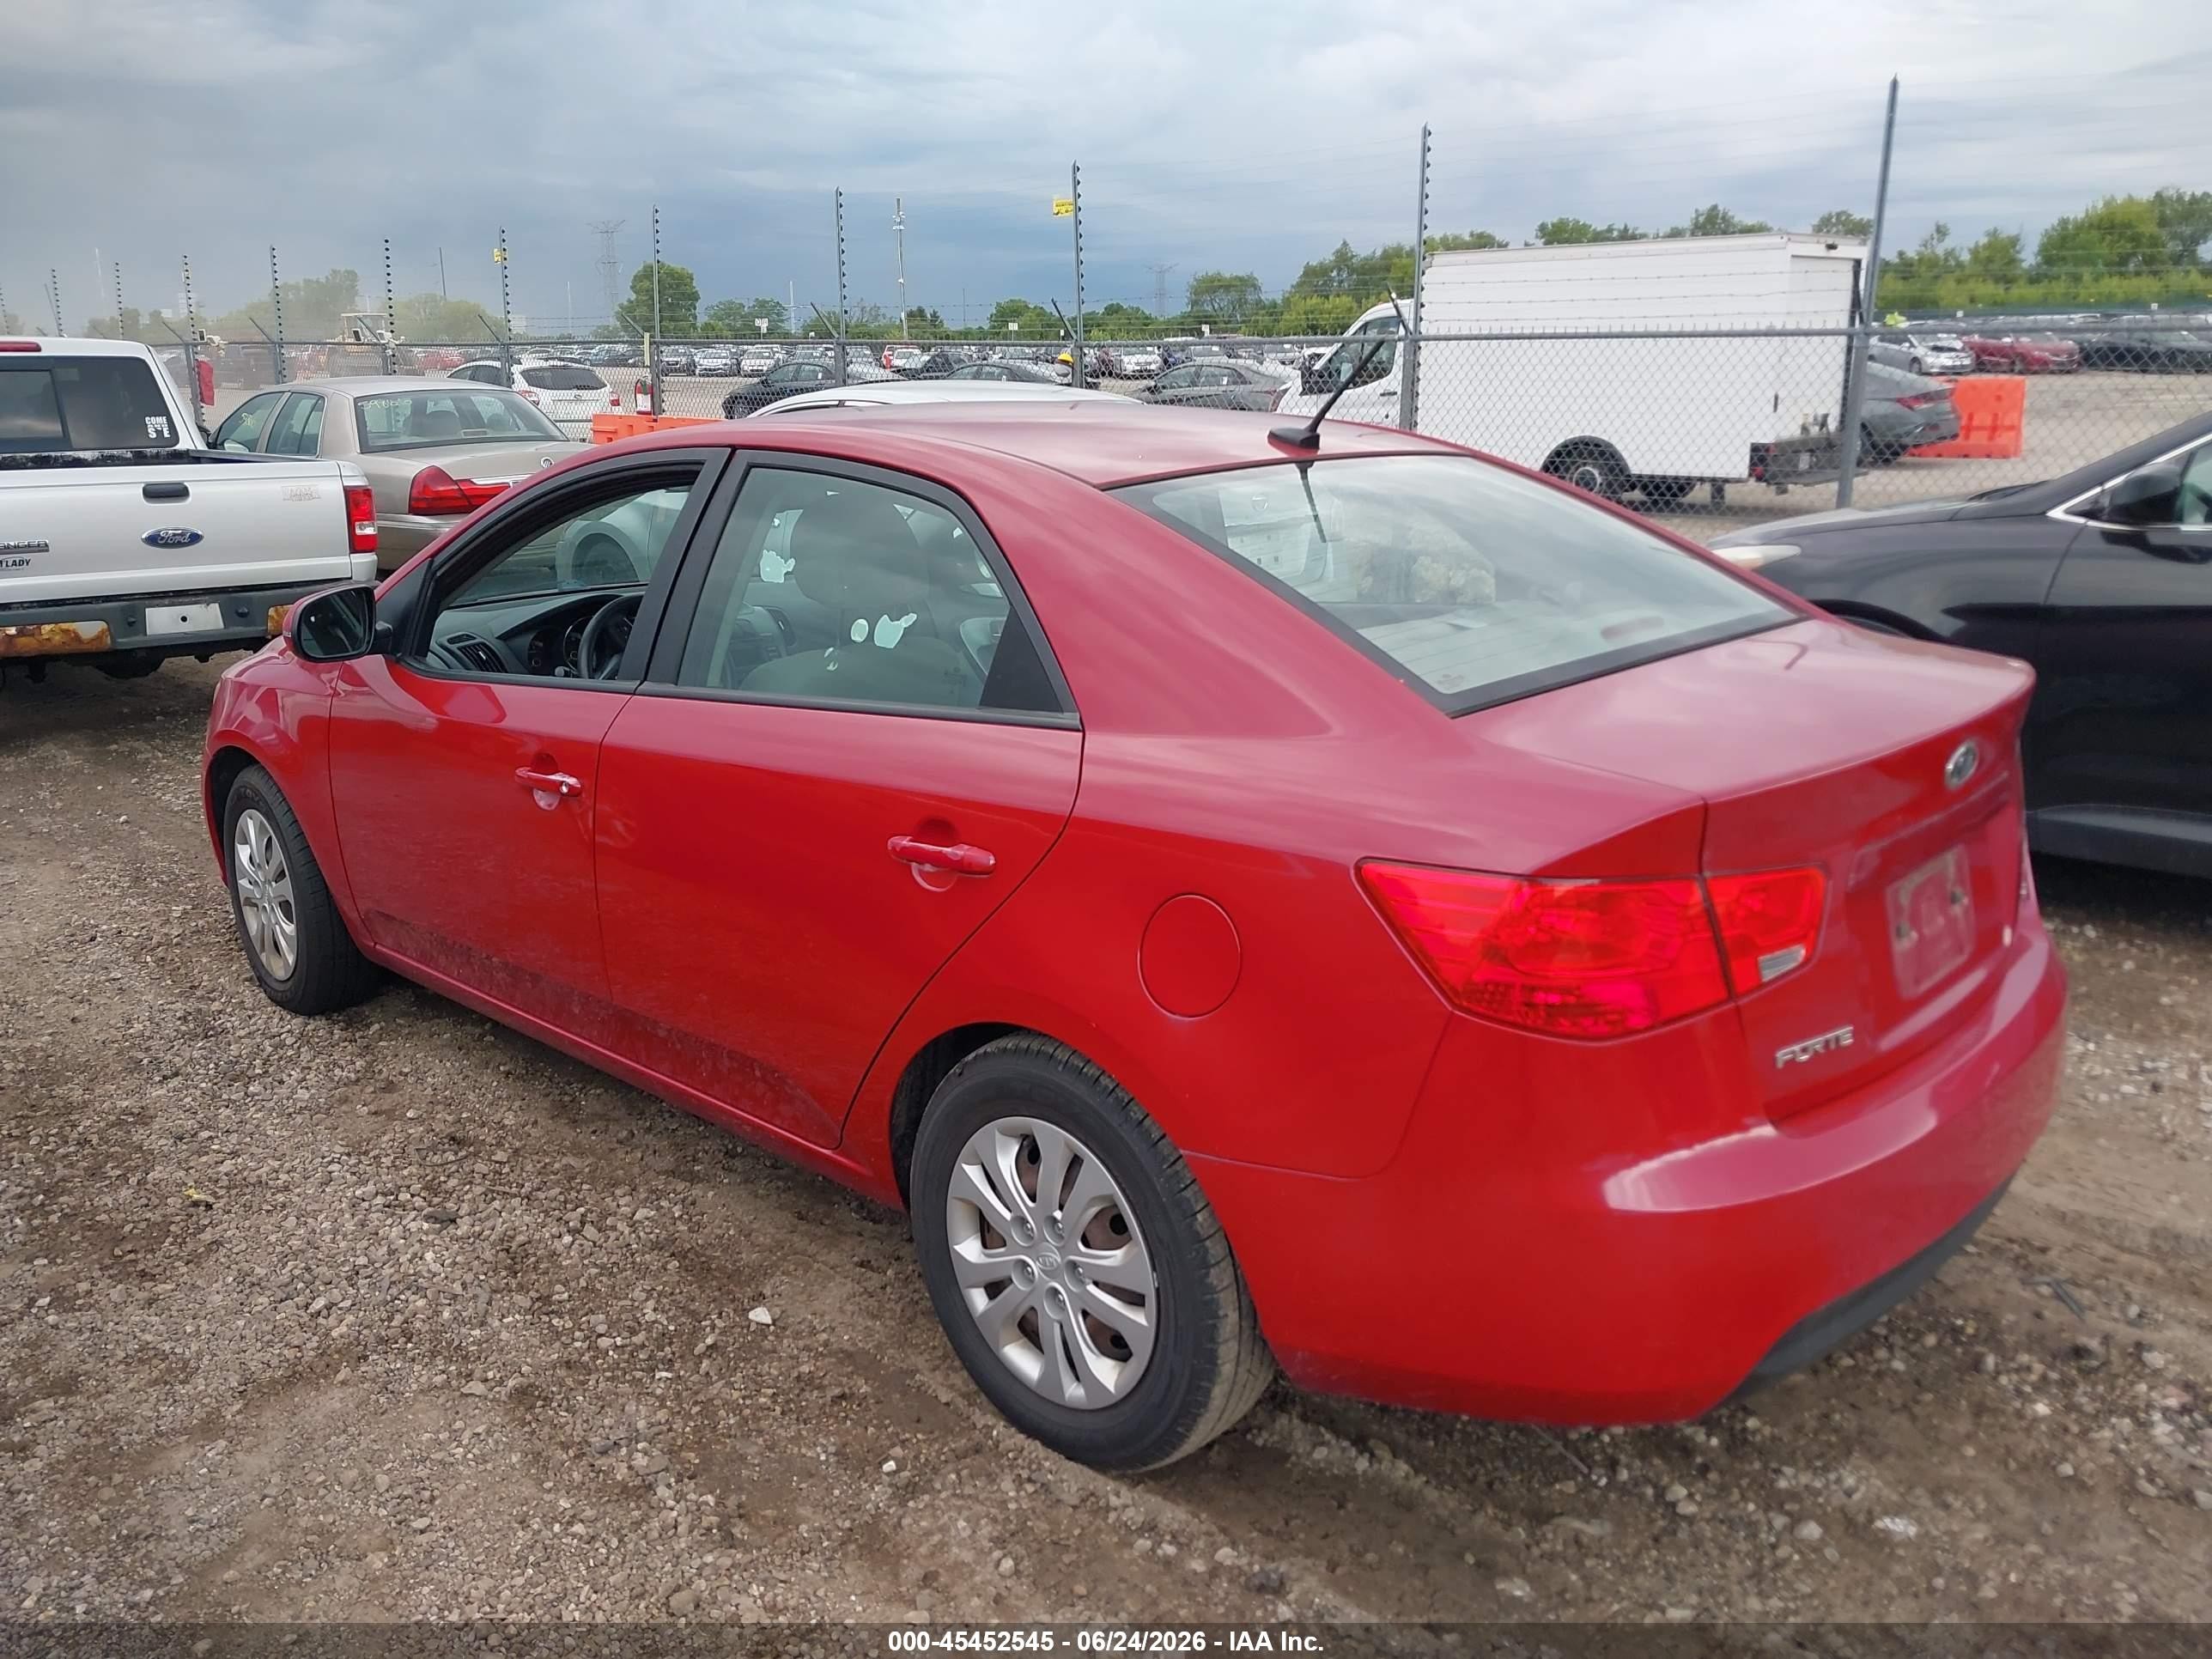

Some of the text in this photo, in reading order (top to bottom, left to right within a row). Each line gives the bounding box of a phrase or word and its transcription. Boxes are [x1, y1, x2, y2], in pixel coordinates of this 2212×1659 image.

[145, 416, 167, 425] COME
[157, 530, 191, 544] Ford
[1775, 1024, 1855, 1069] FORTE
